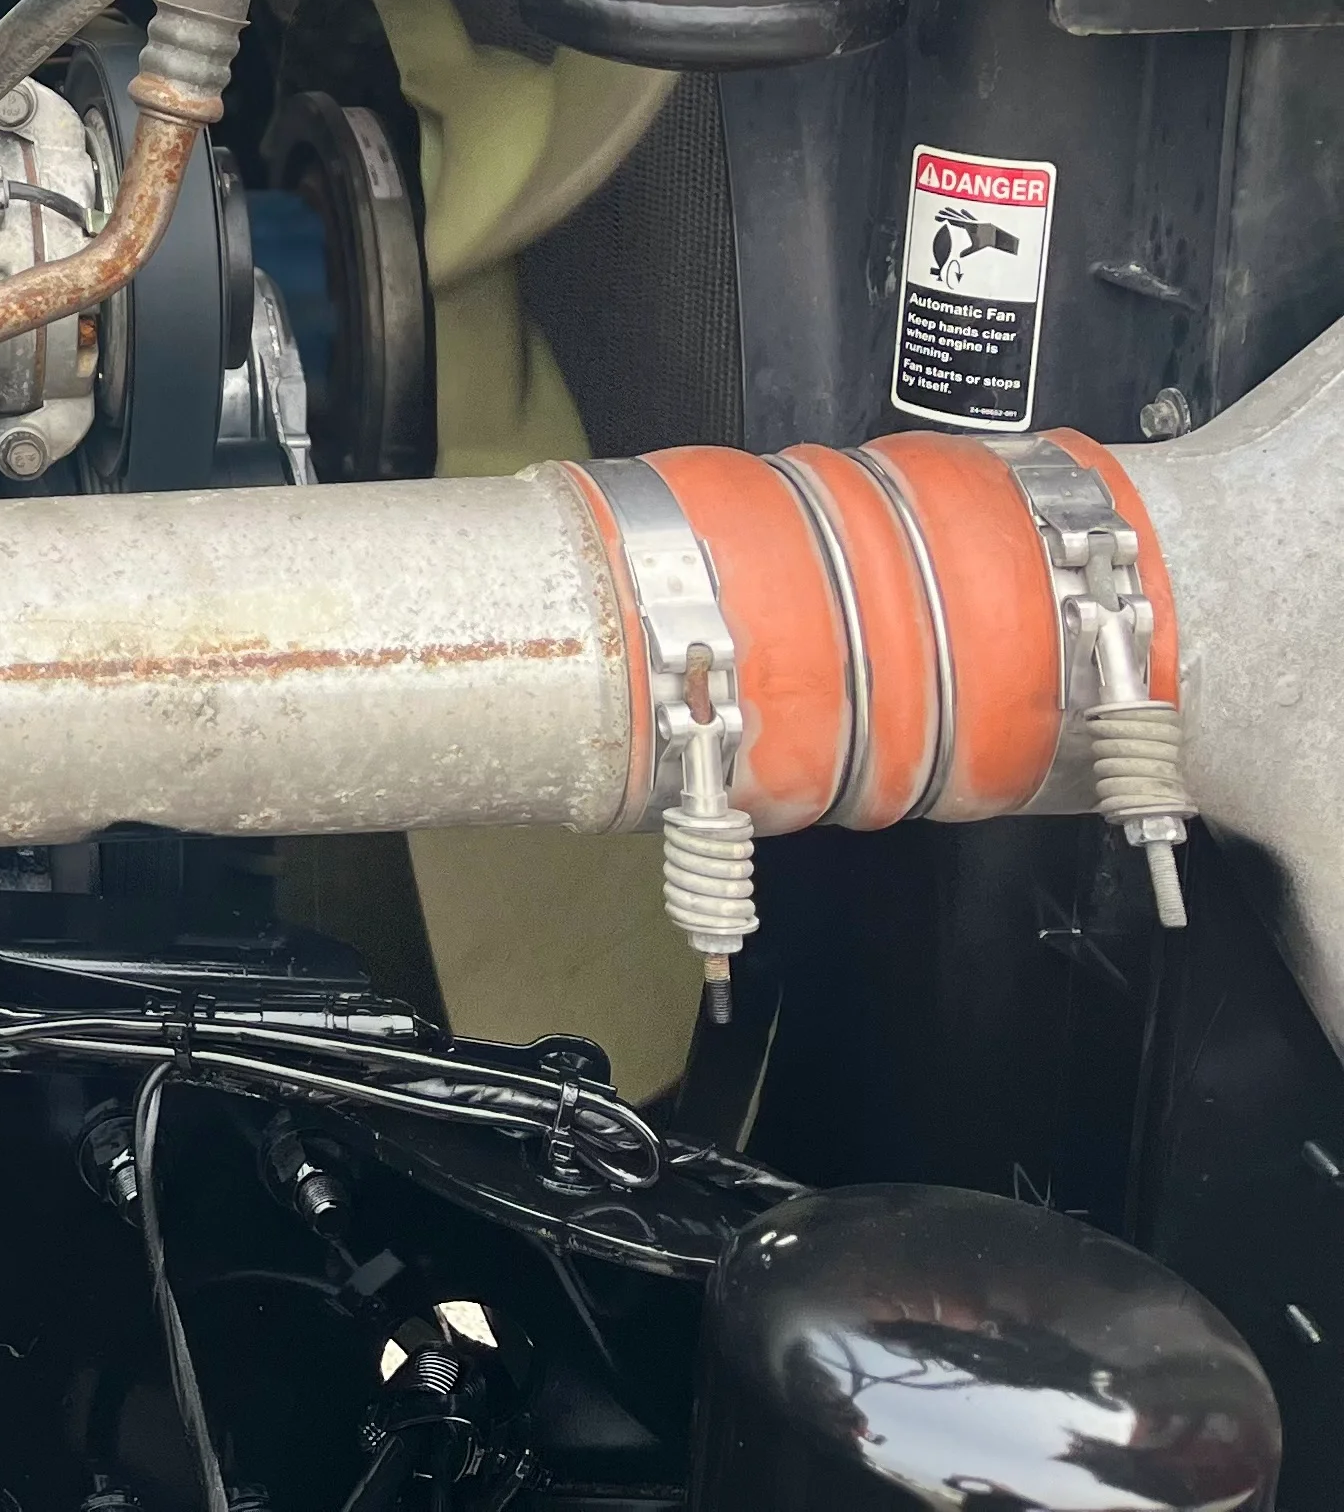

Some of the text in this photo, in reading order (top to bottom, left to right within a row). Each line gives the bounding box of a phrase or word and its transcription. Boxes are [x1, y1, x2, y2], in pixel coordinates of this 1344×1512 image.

[941, 172, 1045, 201] DANGER
[909, 292, 1016, 323] Automatic Fan
[906, 328, 999, 355] when engine is
[907, 313, 1017, 342] Keep hands clear
[904, 341, 953, 363] running.
[902, 372, 953, 395] by itself.
[903, 358, 1021, 390] Fan starts or stops
